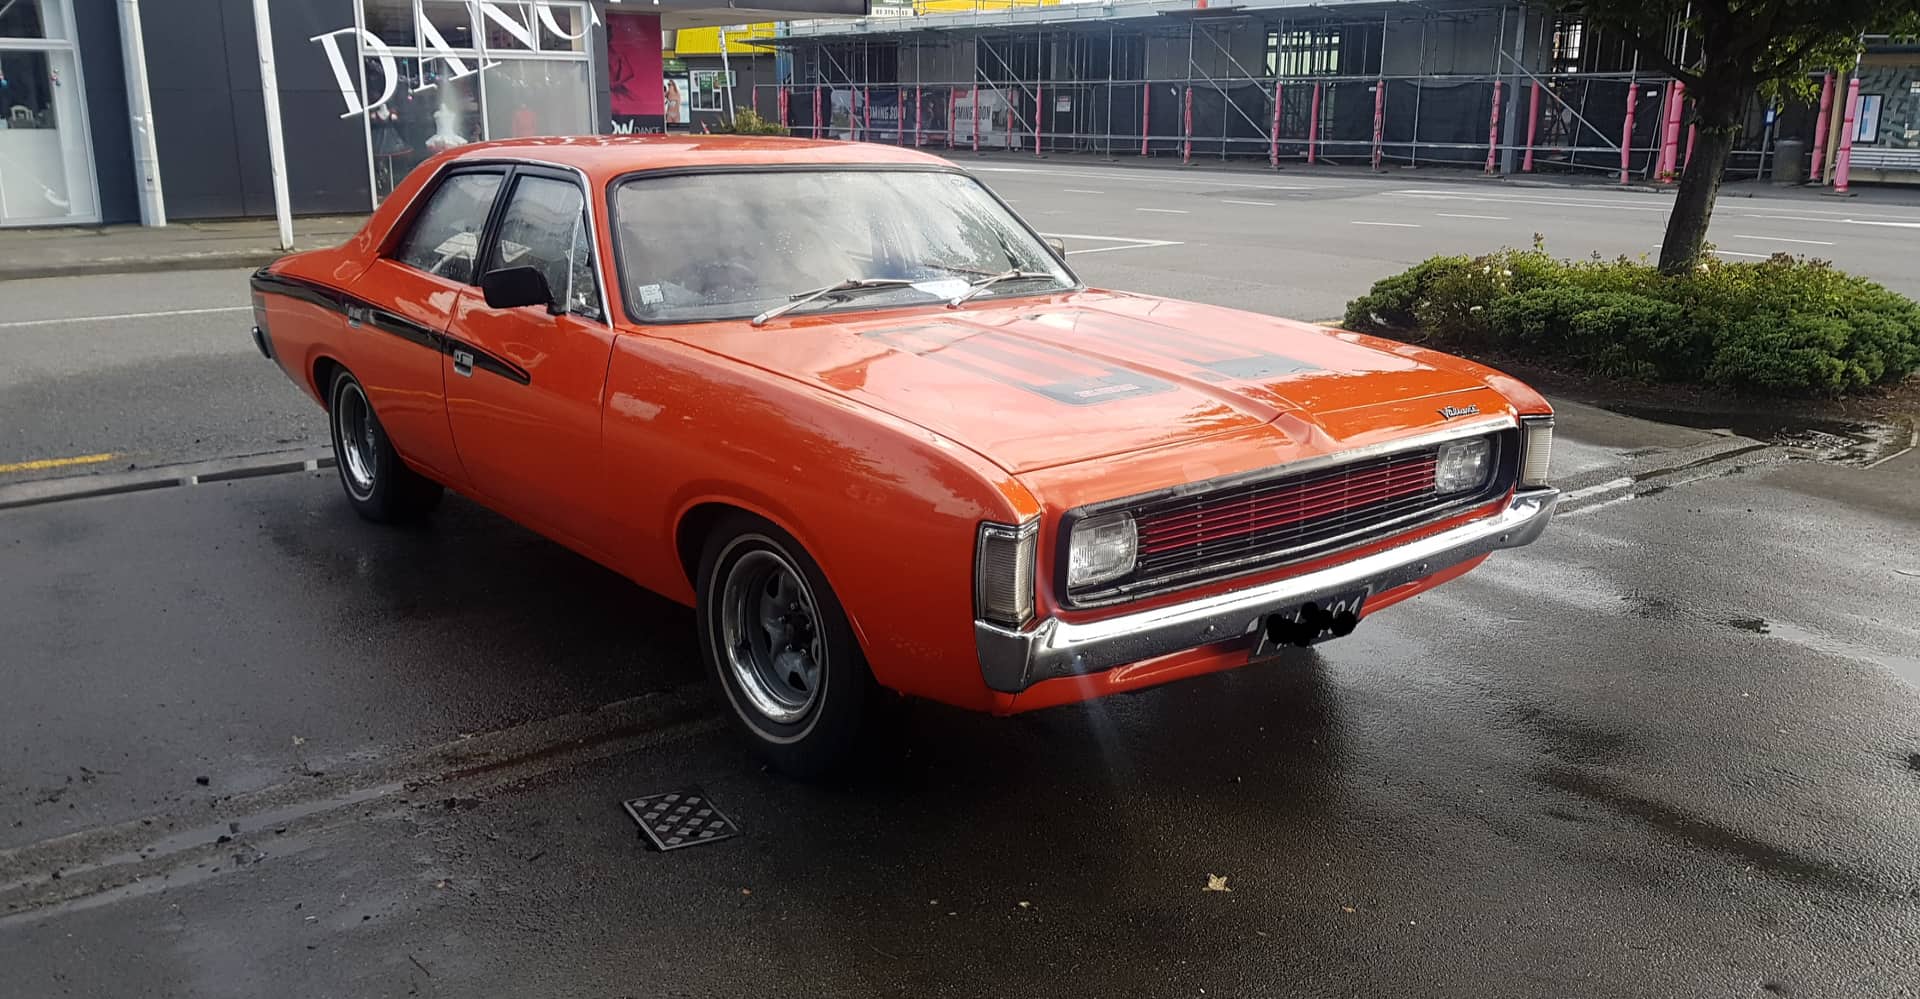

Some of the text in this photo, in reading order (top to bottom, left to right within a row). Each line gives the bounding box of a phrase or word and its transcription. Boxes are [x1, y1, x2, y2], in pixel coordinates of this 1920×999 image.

[310, 0, 621, 119] DANC
[890, 105, 906, 119] SON
[953, 105, 973, 120] OMING
